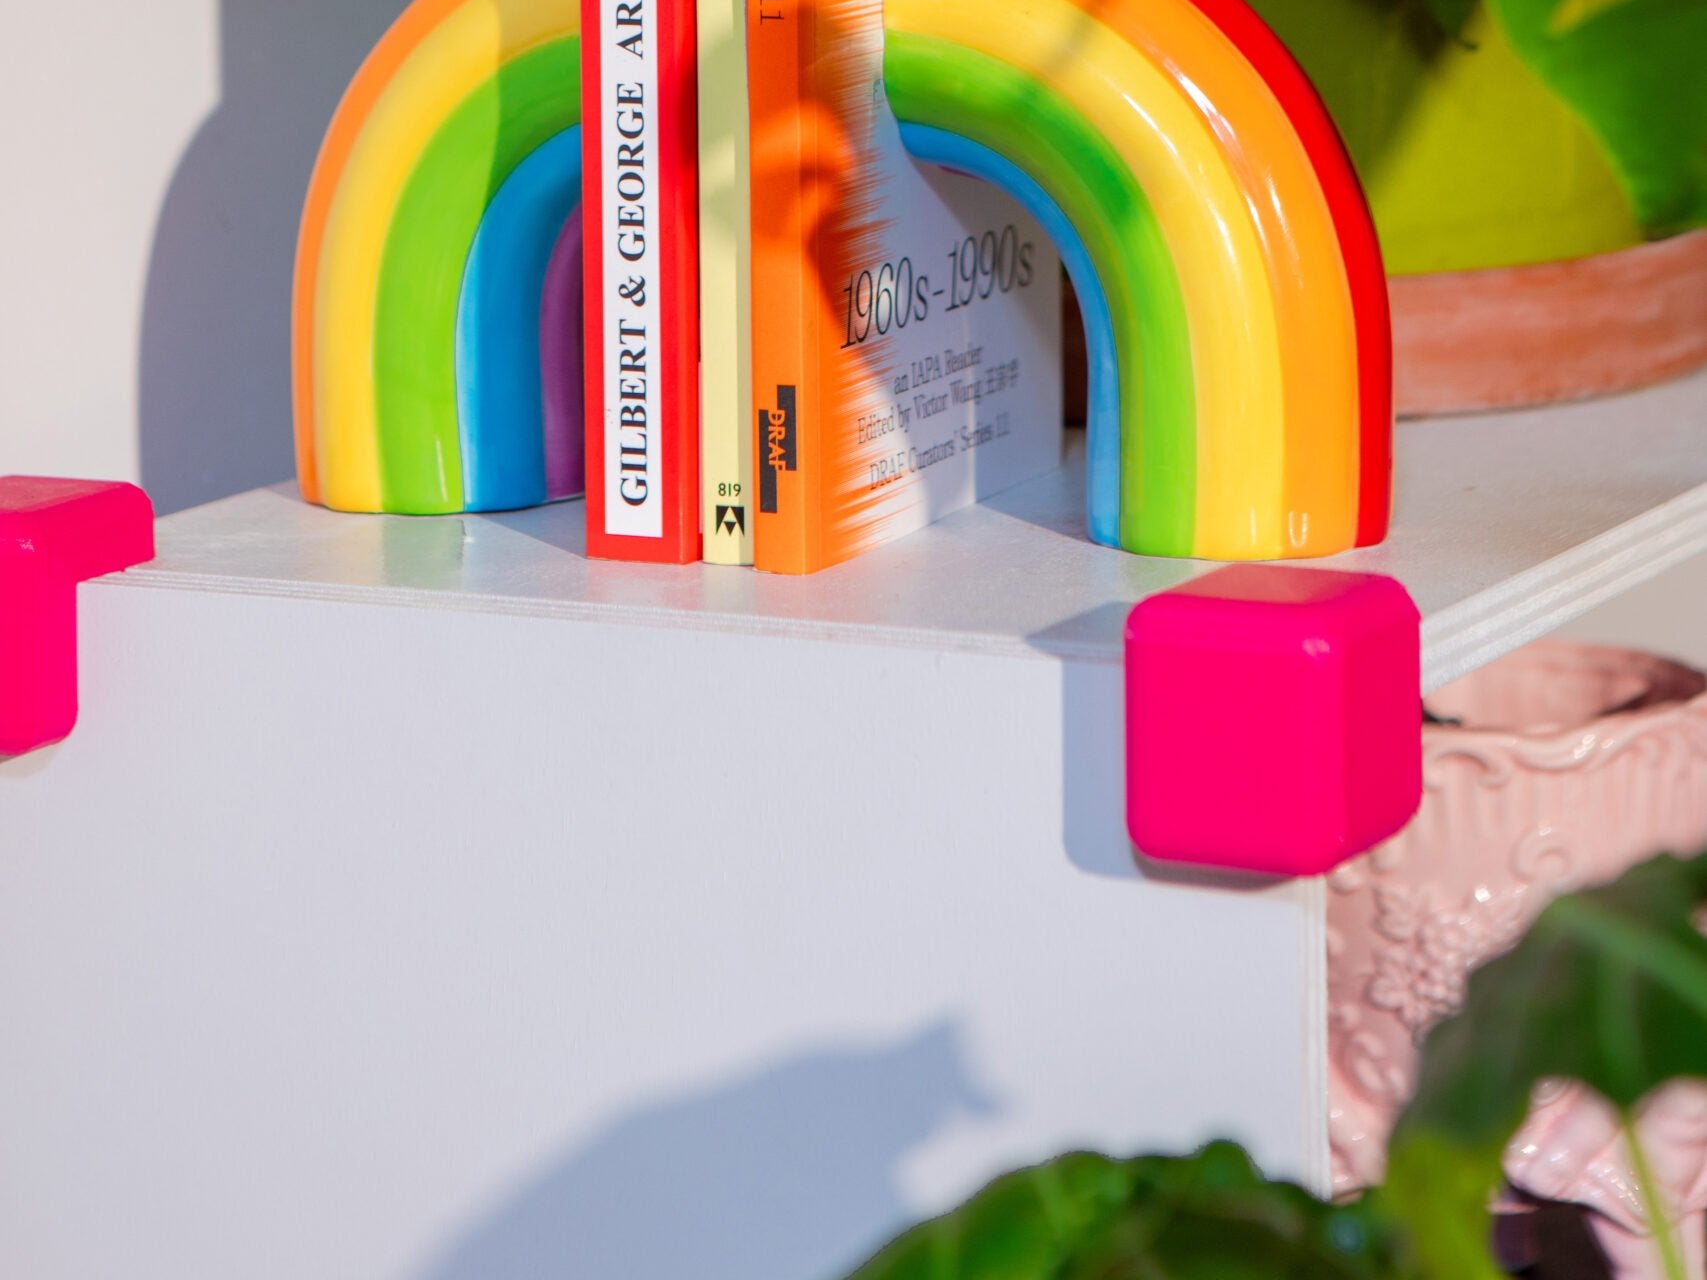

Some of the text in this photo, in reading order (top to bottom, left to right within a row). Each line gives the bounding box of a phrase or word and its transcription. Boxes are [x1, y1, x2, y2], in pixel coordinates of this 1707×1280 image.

[617, 81, 645, 262] GEORGE
[618, 276, 646, 307] &
[619, 318, 648, 507] GILBERT
[768, 409, 786, 471] DRAF
[857, 406, 895, 445] Edited
[897, 403, 912, 433] by
[914, 387, 949, 420] Victor
[718, 483, 741, 497] 819
[869, 454, 906, 490] DRAF
